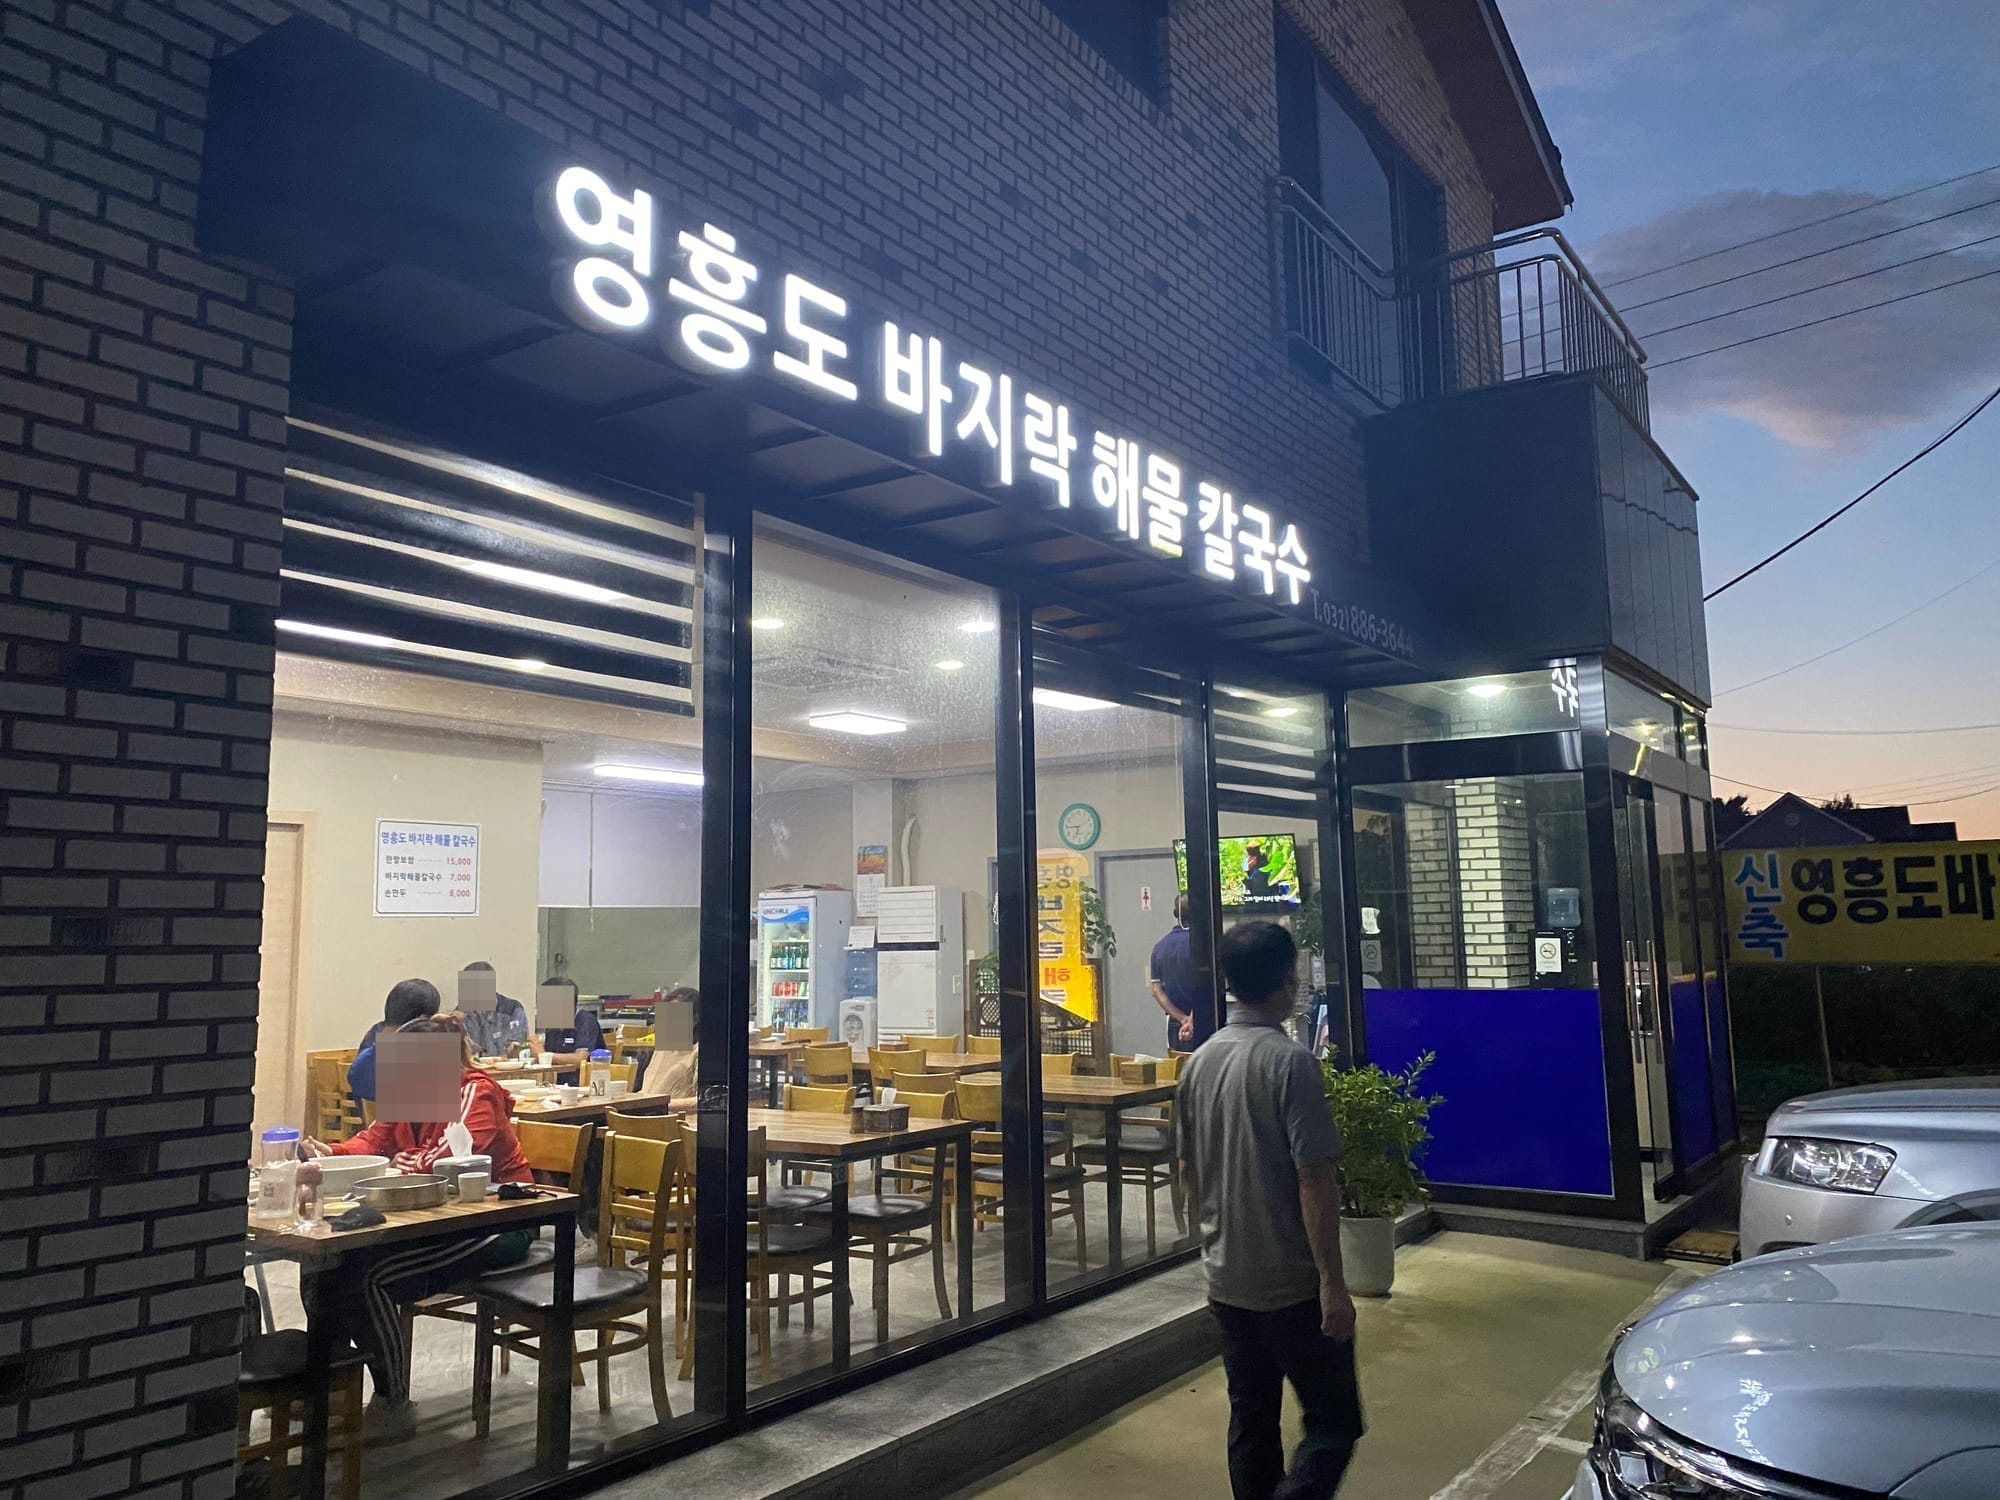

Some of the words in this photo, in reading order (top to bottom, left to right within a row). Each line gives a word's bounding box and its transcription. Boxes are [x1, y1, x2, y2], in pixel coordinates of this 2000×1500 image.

[555, 165, 859, 402] 영흥도
[882, 320, 1078, 509] 바지락
[1091, 430, 1188, 558] 해물
[1198, 481, 1311, 606] 칼국수
[381, 832, 407, 845] 영흥도
[408, 833, 434, 846] 바지락
[435, 835, 451, 847] 해물
[453, 835, 476, 848] 칼국수
[446, 857, 472, 866] 15,000
[384, 872, 442, 882] 바지락해물칼국수
[449, 873, 471, 882] 7,000
[384, 888, 407, 898] 손만두
[1790, 851, 2000, 925] 영흥도바
[1733, 851, 1790, 961] 신축
